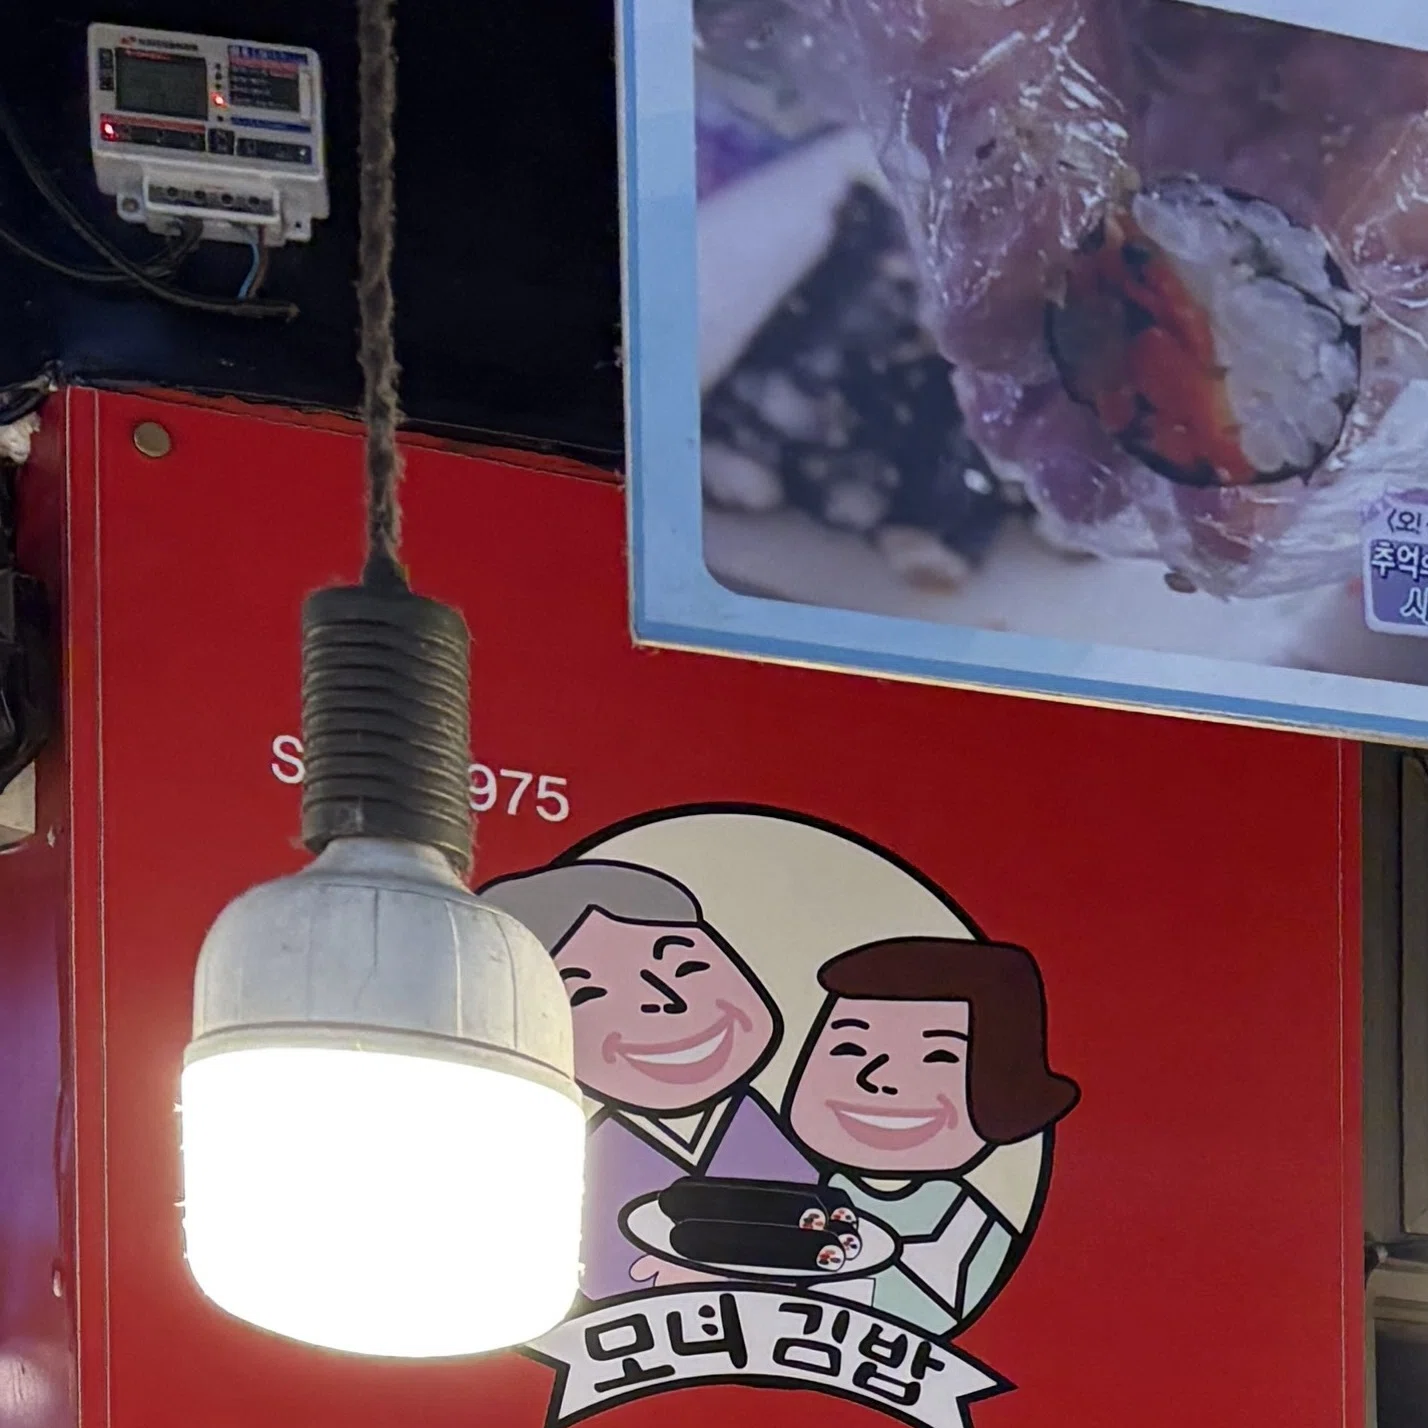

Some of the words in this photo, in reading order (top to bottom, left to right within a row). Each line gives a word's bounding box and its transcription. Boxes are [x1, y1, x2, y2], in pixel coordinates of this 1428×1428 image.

[468, 764, 570, 824] 975
[585, 1291, 749, 1394] 모녀
[770, 1300, 946, 1408] 김밥
